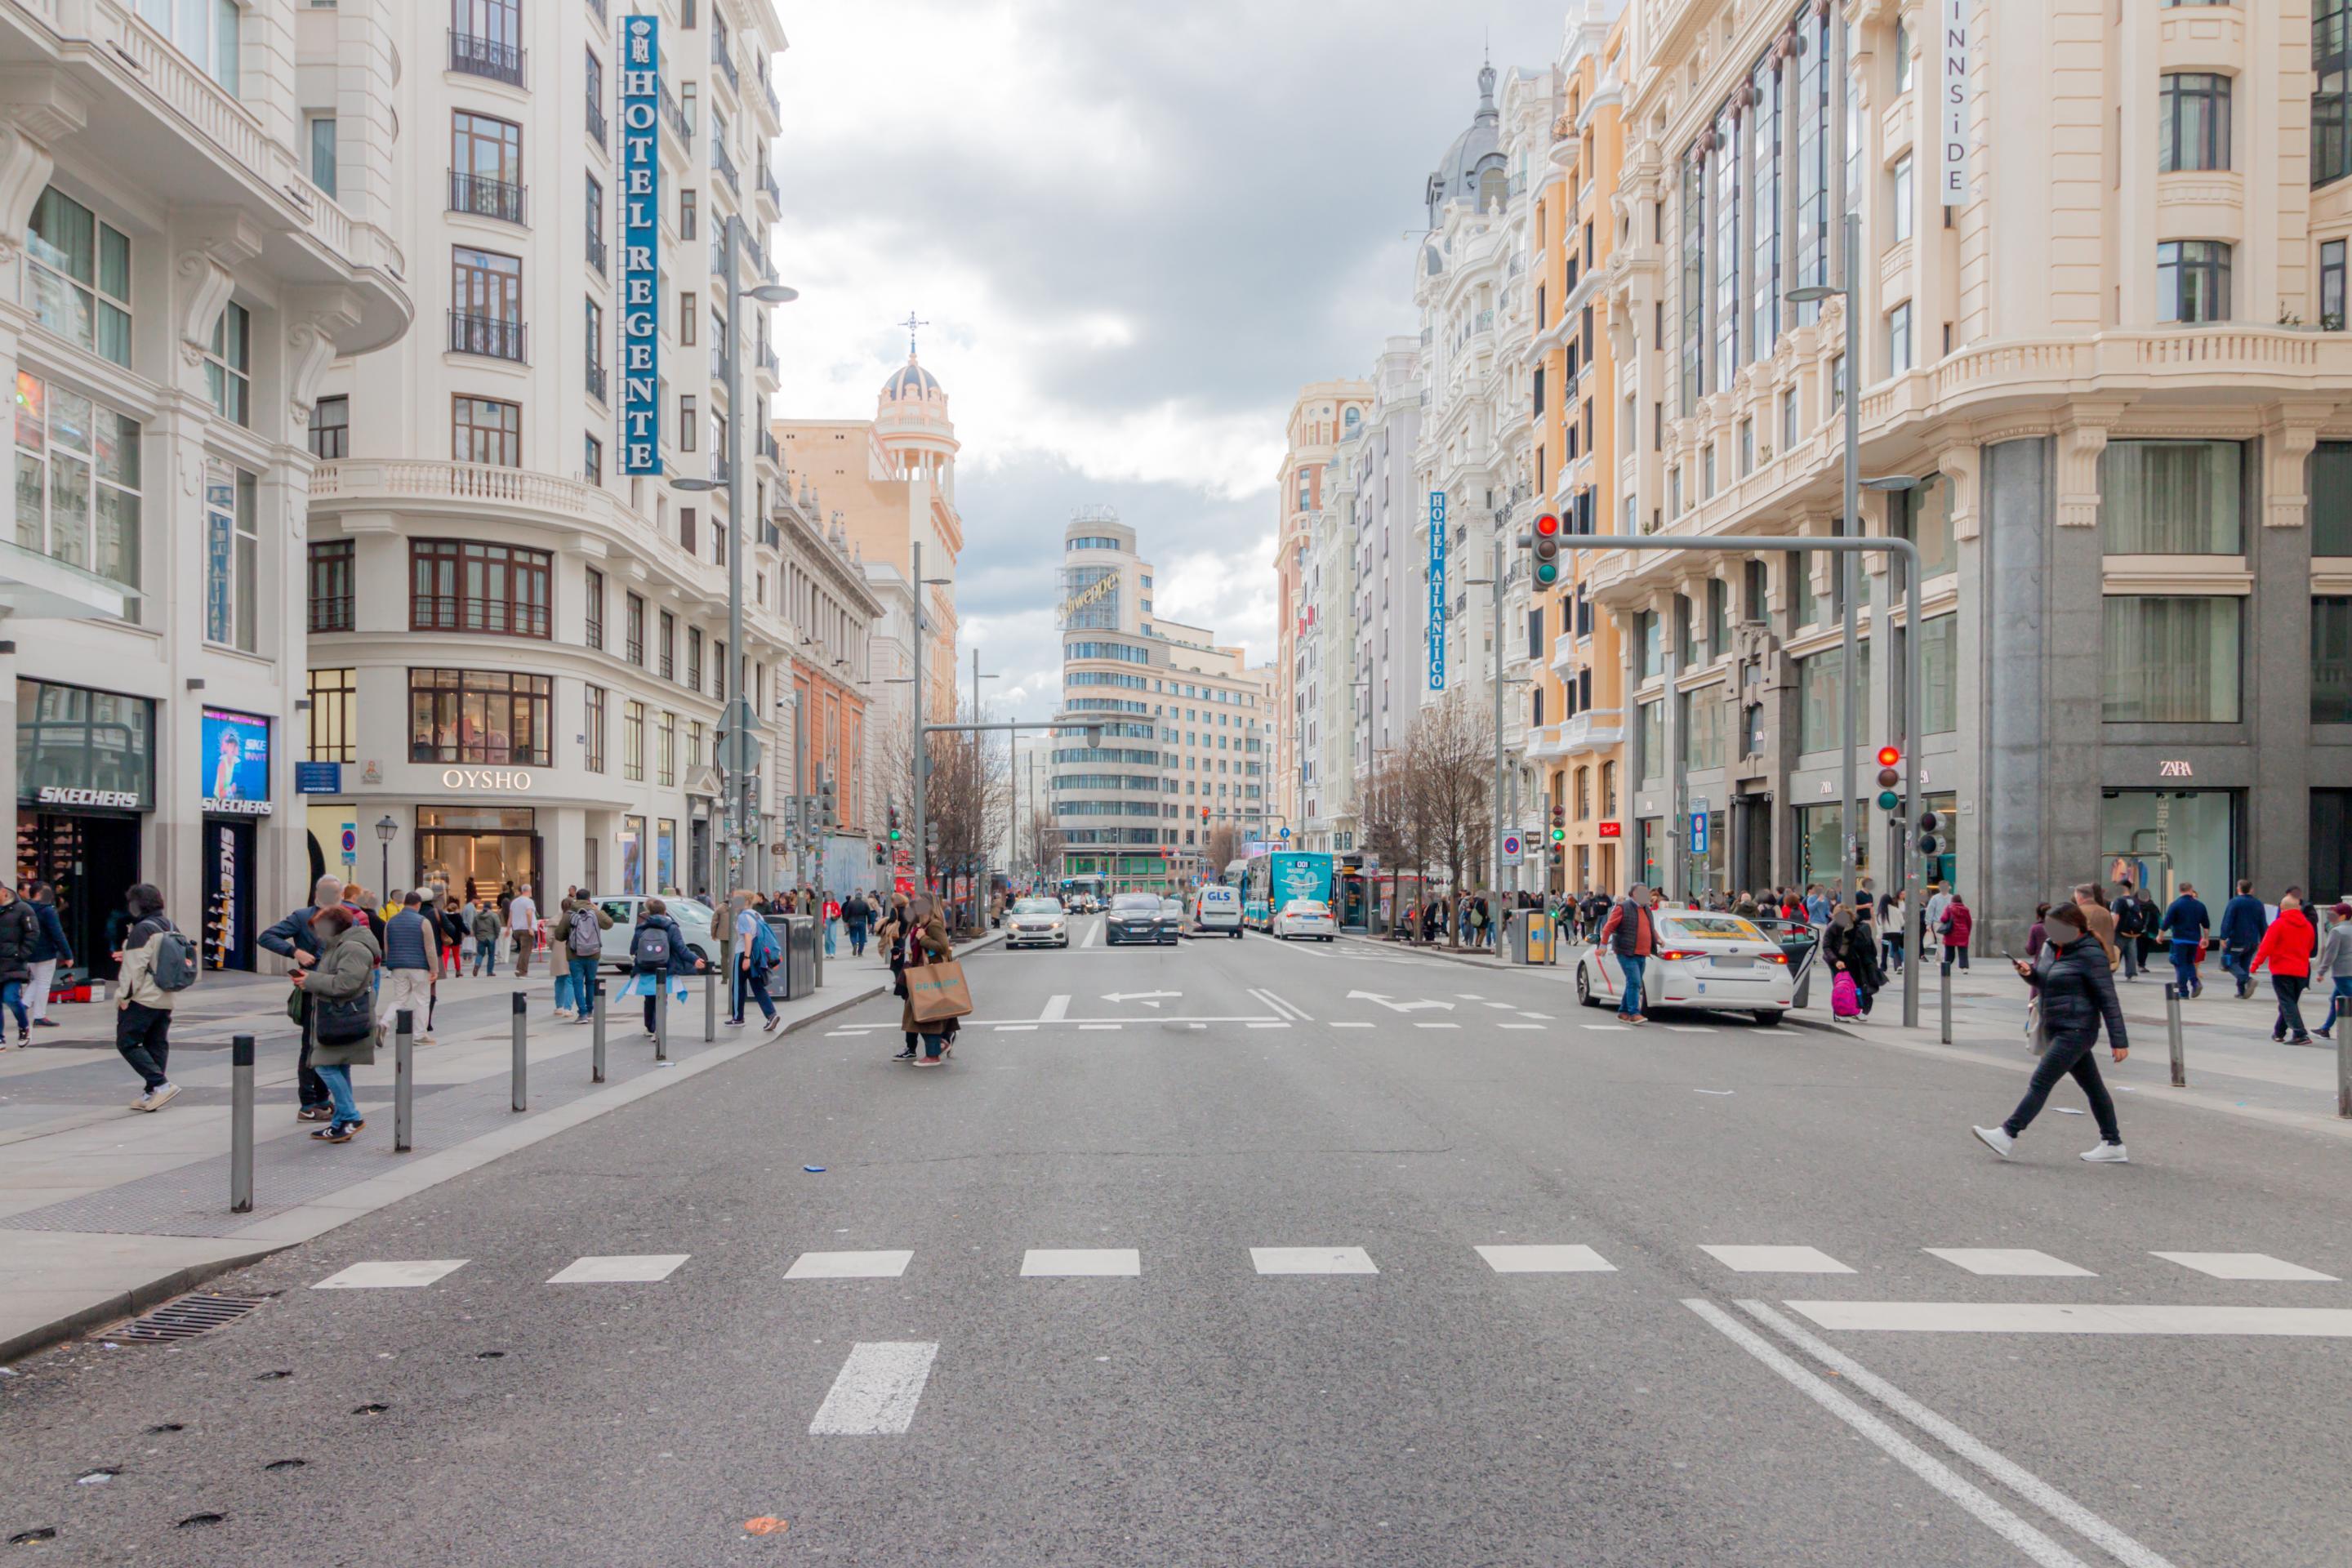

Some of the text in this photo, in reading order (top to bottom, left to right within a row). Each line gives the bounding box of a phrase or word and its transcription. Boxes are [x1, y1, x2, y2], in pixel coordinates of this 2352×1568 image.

[625, 70, 657, 469] HOTEL REGENTE
[1431, 495, 1444, 687] HOTEL ATLANTICO
[443, 769, 531, 790] OYSHO
[2159, 761, 2194, 777] ZARA
[38, 786, 140, 808] SKECHERS
[201, 797, 274, 815] SKECHERS
